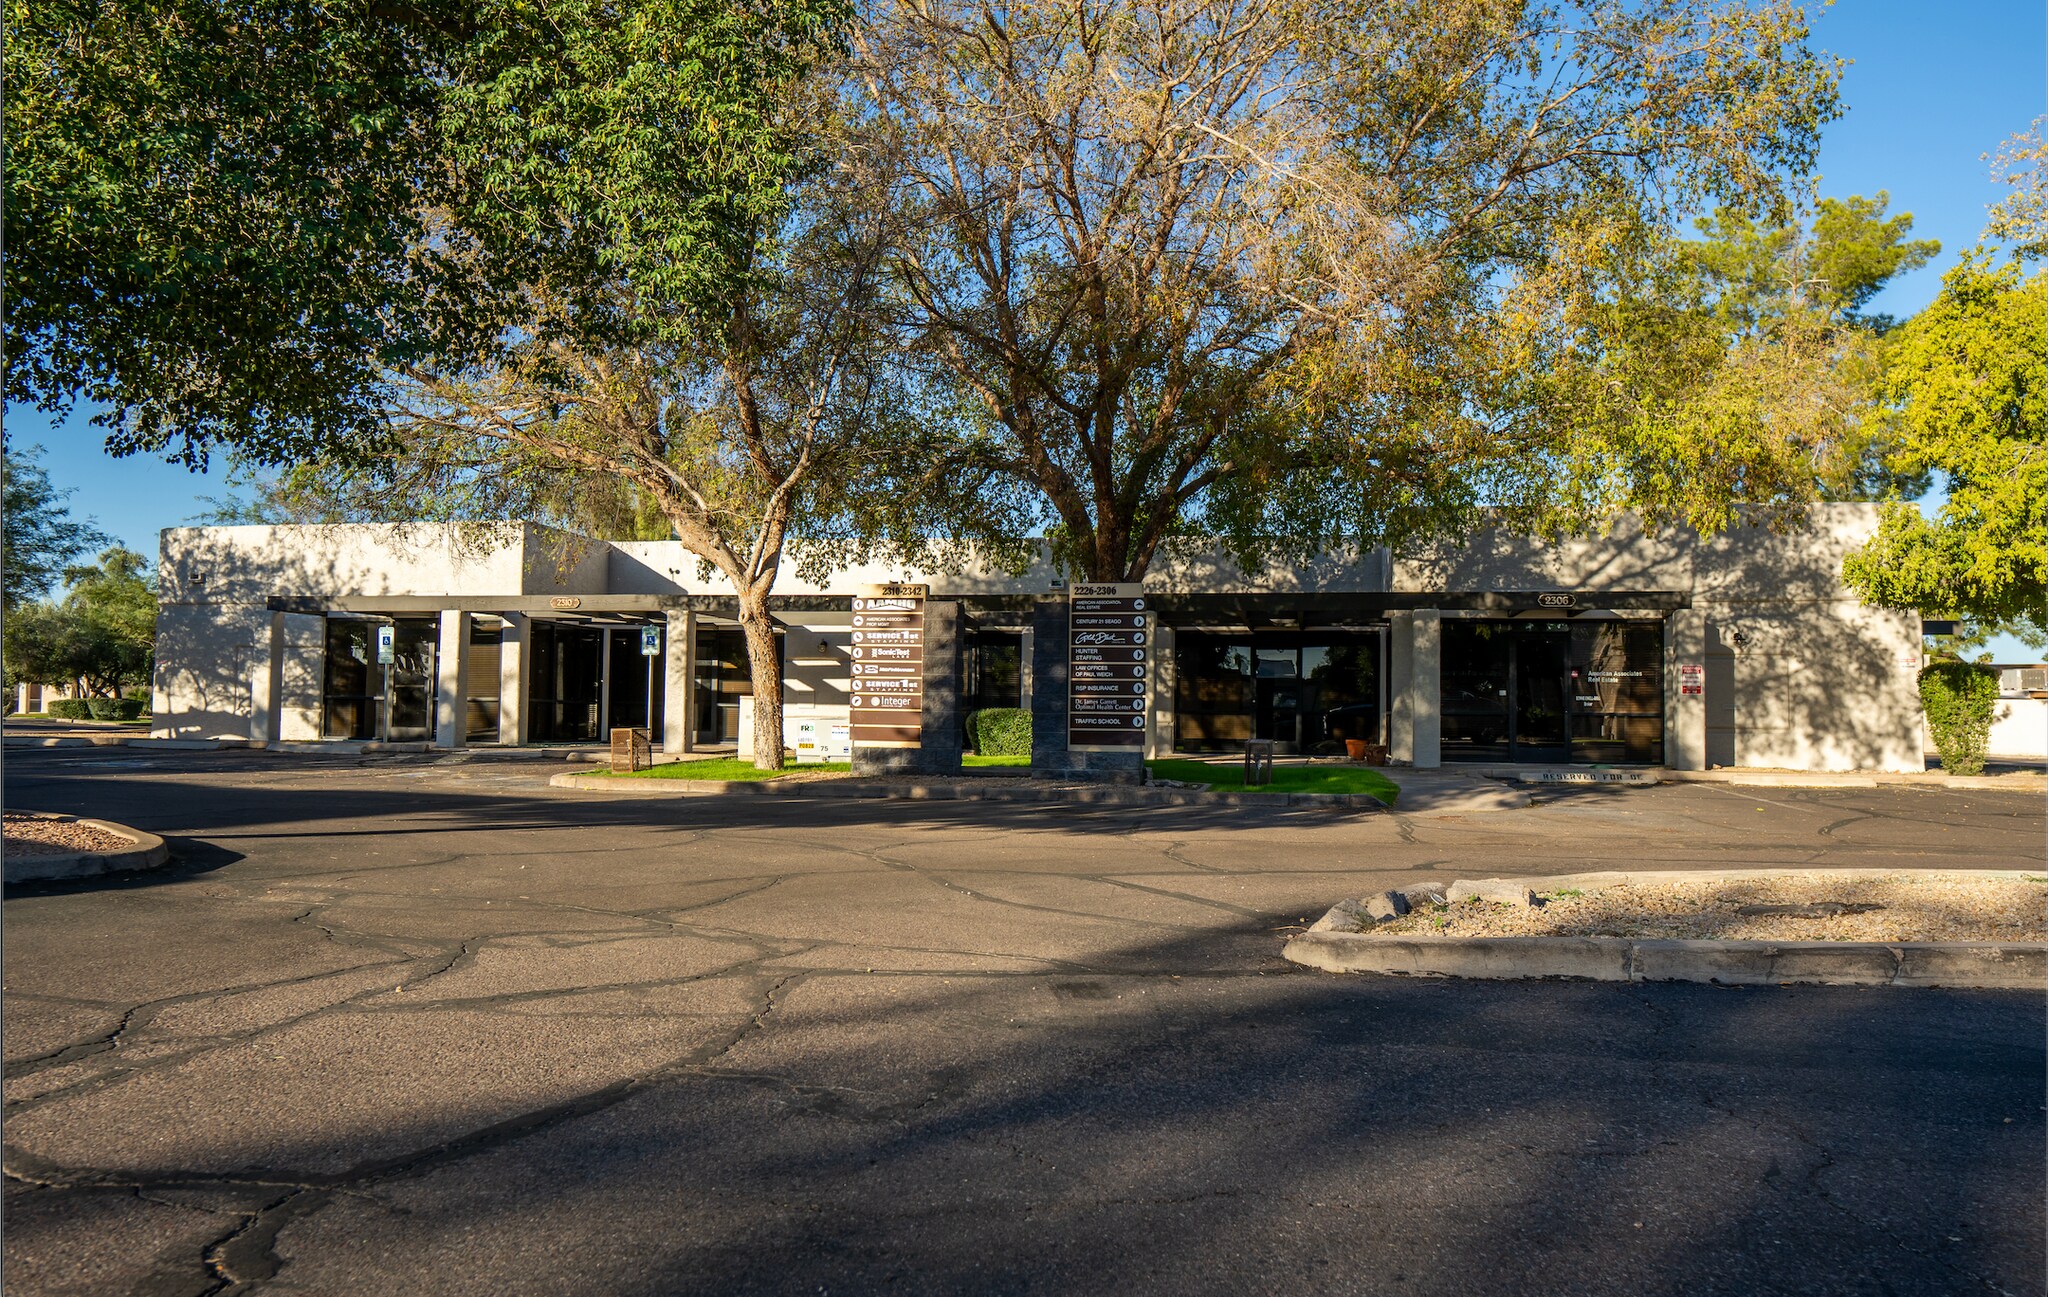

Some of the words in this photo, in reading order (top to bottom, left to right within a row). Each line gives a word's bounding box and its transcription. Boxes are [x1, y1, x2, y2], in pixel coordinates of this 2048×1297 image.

[882, 587, 922, 596] 2310-2342
[1074, 586, 1117, 595] 2226-2306
[866, 599, 916, 611] AAMHO
[1545, 596, 1569, 605] 2306
[881, 696, 912, 708] Integer
